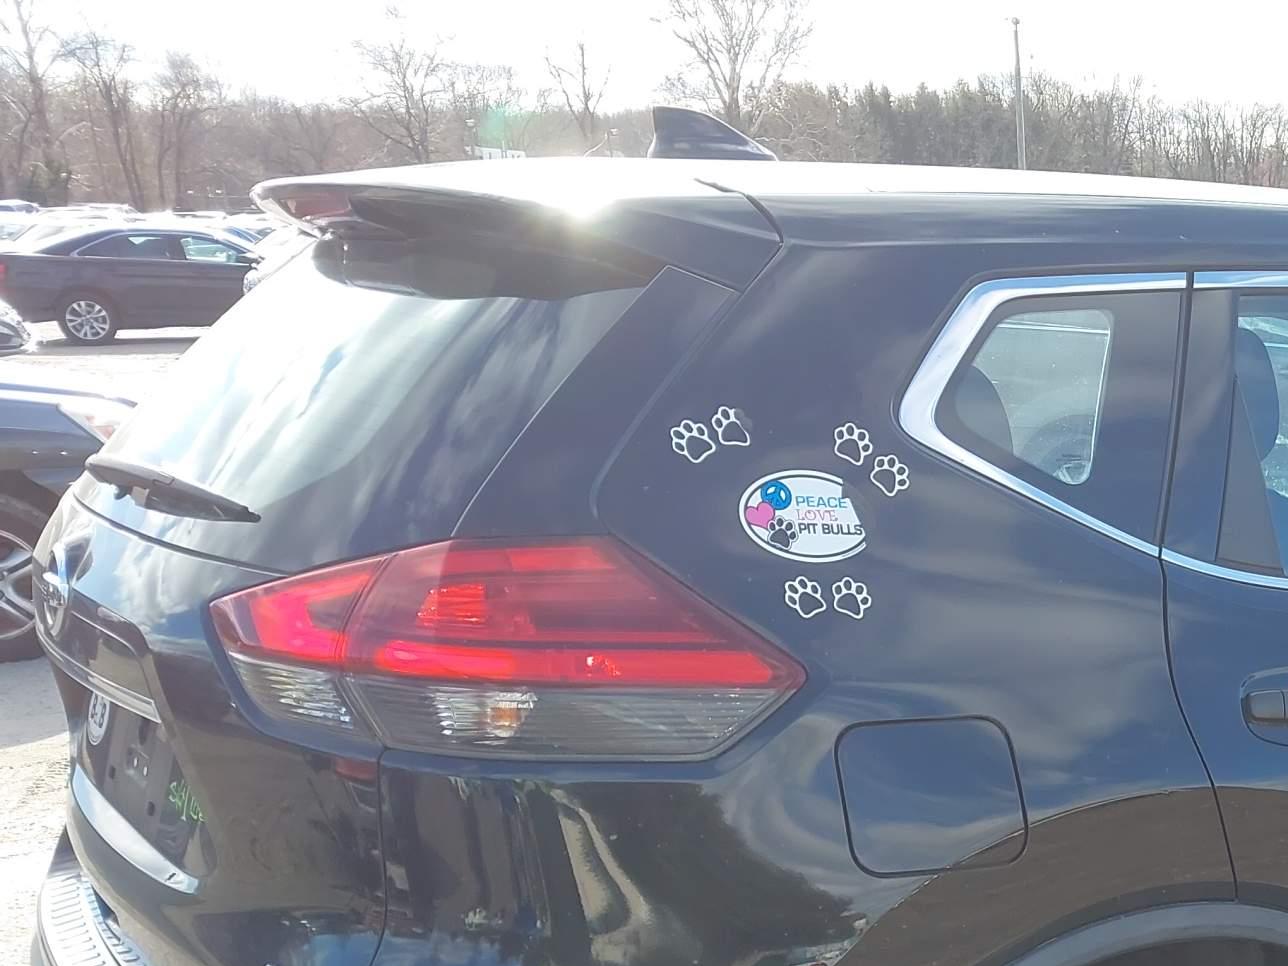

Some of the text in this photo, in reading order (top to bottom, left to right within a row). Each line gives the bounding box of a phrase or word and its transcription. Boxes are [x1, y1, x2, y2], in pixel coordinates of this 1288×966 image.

[795, 495, 848, 508] PEACE
[795, 509, 838, 522] LOVE
[798, 522, 863, 536] PIT BULLS
